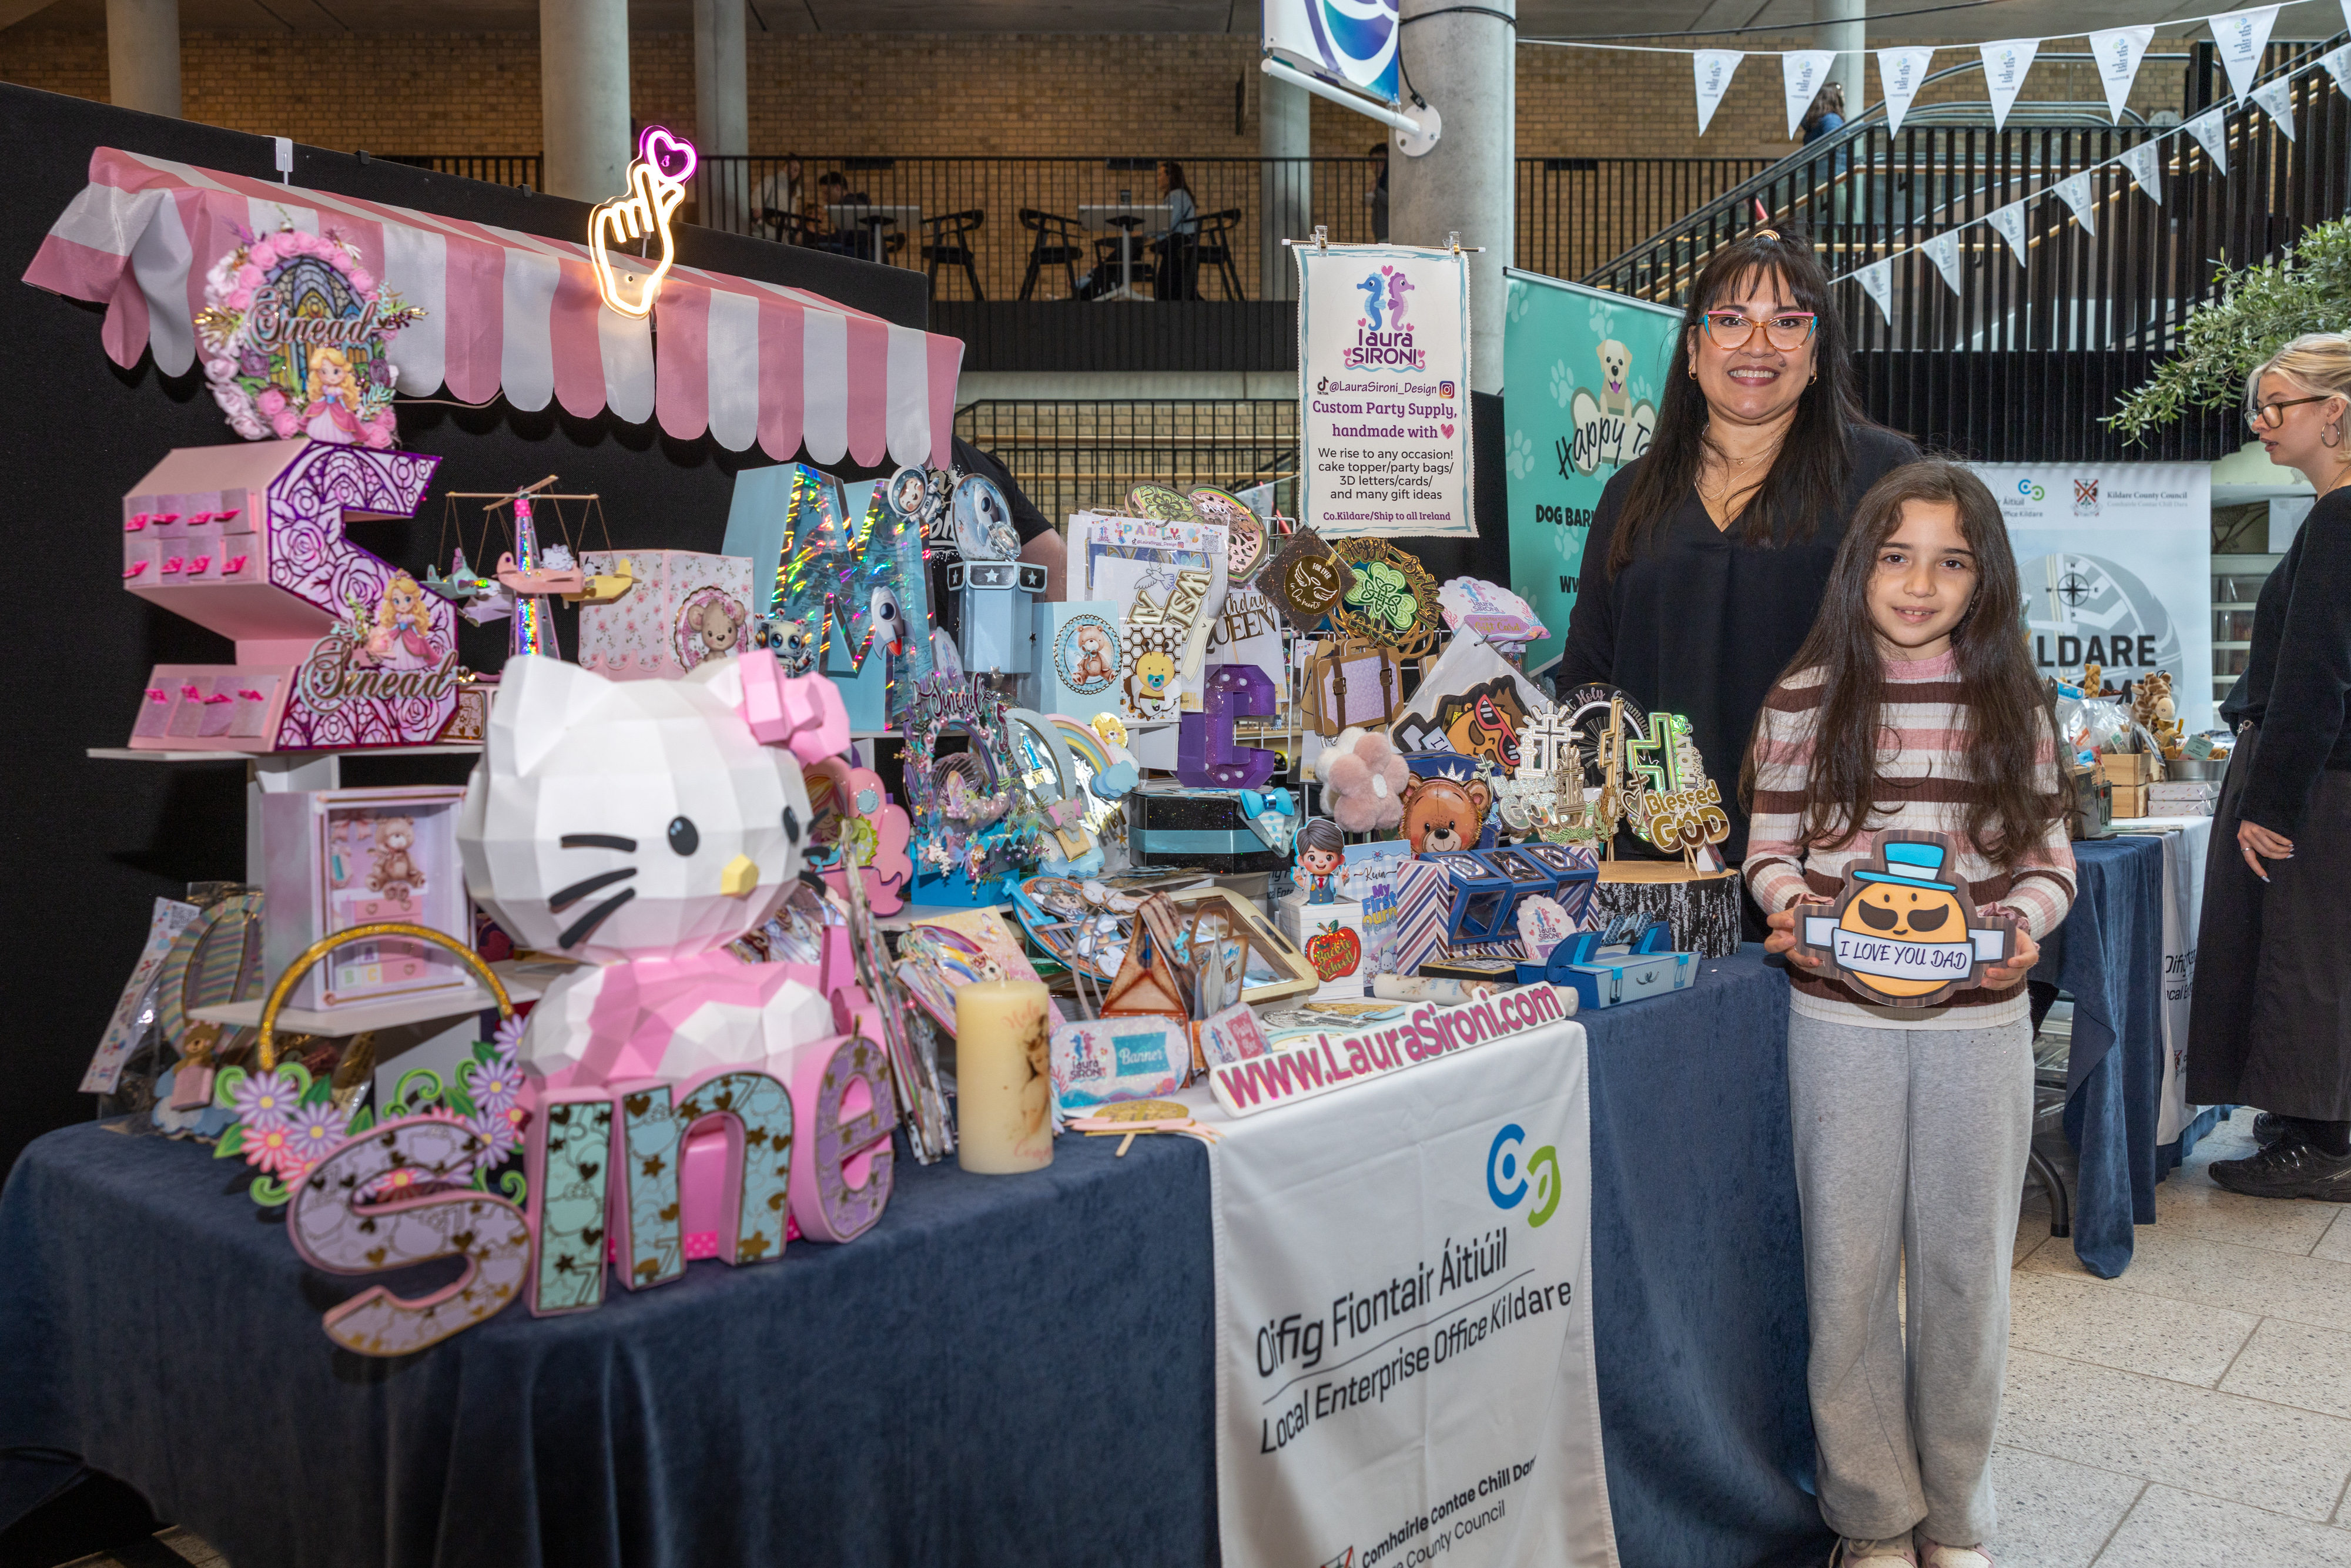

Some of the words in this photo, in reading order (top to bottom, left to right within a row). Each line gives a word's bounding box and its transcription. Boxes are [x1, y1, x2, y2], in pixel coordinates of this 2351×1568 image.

[1352, 347, 1417, 365] SIRONI
[1329, 381, 1437, 396] @LauraSironi_Design
[1312, 400, 1363, 414] Custom
[1366, 402, 1405, 418] Party
[1408, 403, 1458, 419] Supply,
[1332, 424, 1405, 438] handmade
[1407, 425, 1439, 439] with
[1318, 448, 1337, 458] We
[1340, 448, 1360, 458] rise
[1362, 449, 1375, 458] to
[1377, 451, 1399, 461] any
[1401, 450, 1454, 460] occasion!
[1555, 417, 1626, 480] Happy
[1318, 461, 1345, 471] cake
[1348, 461, 1420, 474] topper/party
[1423, 462, 1454, 475] bags/
[1339, 475, 1356, 485] 3D
[1359, 475, 1433, 487] letters/cards/
[1330, 489, 1352, 499] and
[1355, 491, 1388, 501] many
[1391, 489, 1410, 501] gift
[1413, 490, 1442, 500] ideas
[2106, 491, 2132, 500] Kildare
[2134, 491, 2159, 501] County
[2161, 491, 2188, 500] Council
[1322, 511, 1394, 522] Co.Kildare/Ship
[1395, 512, 1404, 520] to
[1406, 512, 1418, 521] all
[1419, 512, 1451, 521] Ireland
[1536, 504, 1563, 525] DOG
[1123, 524, 1180, 538] PARTY
[1312, 562, 1321, 572] FOR
[1320, 567, 1332, 579] EVER
[1475, 622, 1496, 633] Gift
[1497, 623, 1521, 631] Card
[2037, 635, 2157, 667] LDARE
[300, 636, 458, 713] Sinead
[1575, 688, 1605, 706] Holy
[1645, 779, 1722, 816] Blessed
[1651, 806, 1730, 852] GOD
[1357, 866, 1393, 882] Kevin
[1372, 883, 1390, 898] My
[1361, 890, 1398, 916] First
[1538, 932, 1560, 940] SIRONI
[1316, 943, 1341, 964] Back
[1838, 941, 1850, 957] I
[1853, 942, 1891, 961] LOVE
[1894, 946, 1927, 965] YOU
[1930, 950, 1967, 970] DAD
[1118, 1047, 1164, 1065] Banner
[1257, 1314, 1324, 1378] Oifig
[1332, 1262, 1435, 1348] Fiontair
[1439, 1227, 1507, 1296] Áitiúil
[1260, 1389, 1309, 1455] Local
[1315, 1346, 1430, 1420] Enterprise
[1434, 1316, 1488, 1364] Office
[1490, 1281, 1572, 1334] Kildare
[1478, 1468, 1511, 1497] Chill
[1406, 1530, 1452, 1568] County
[1454, 1499, 1505, 1539] Council
